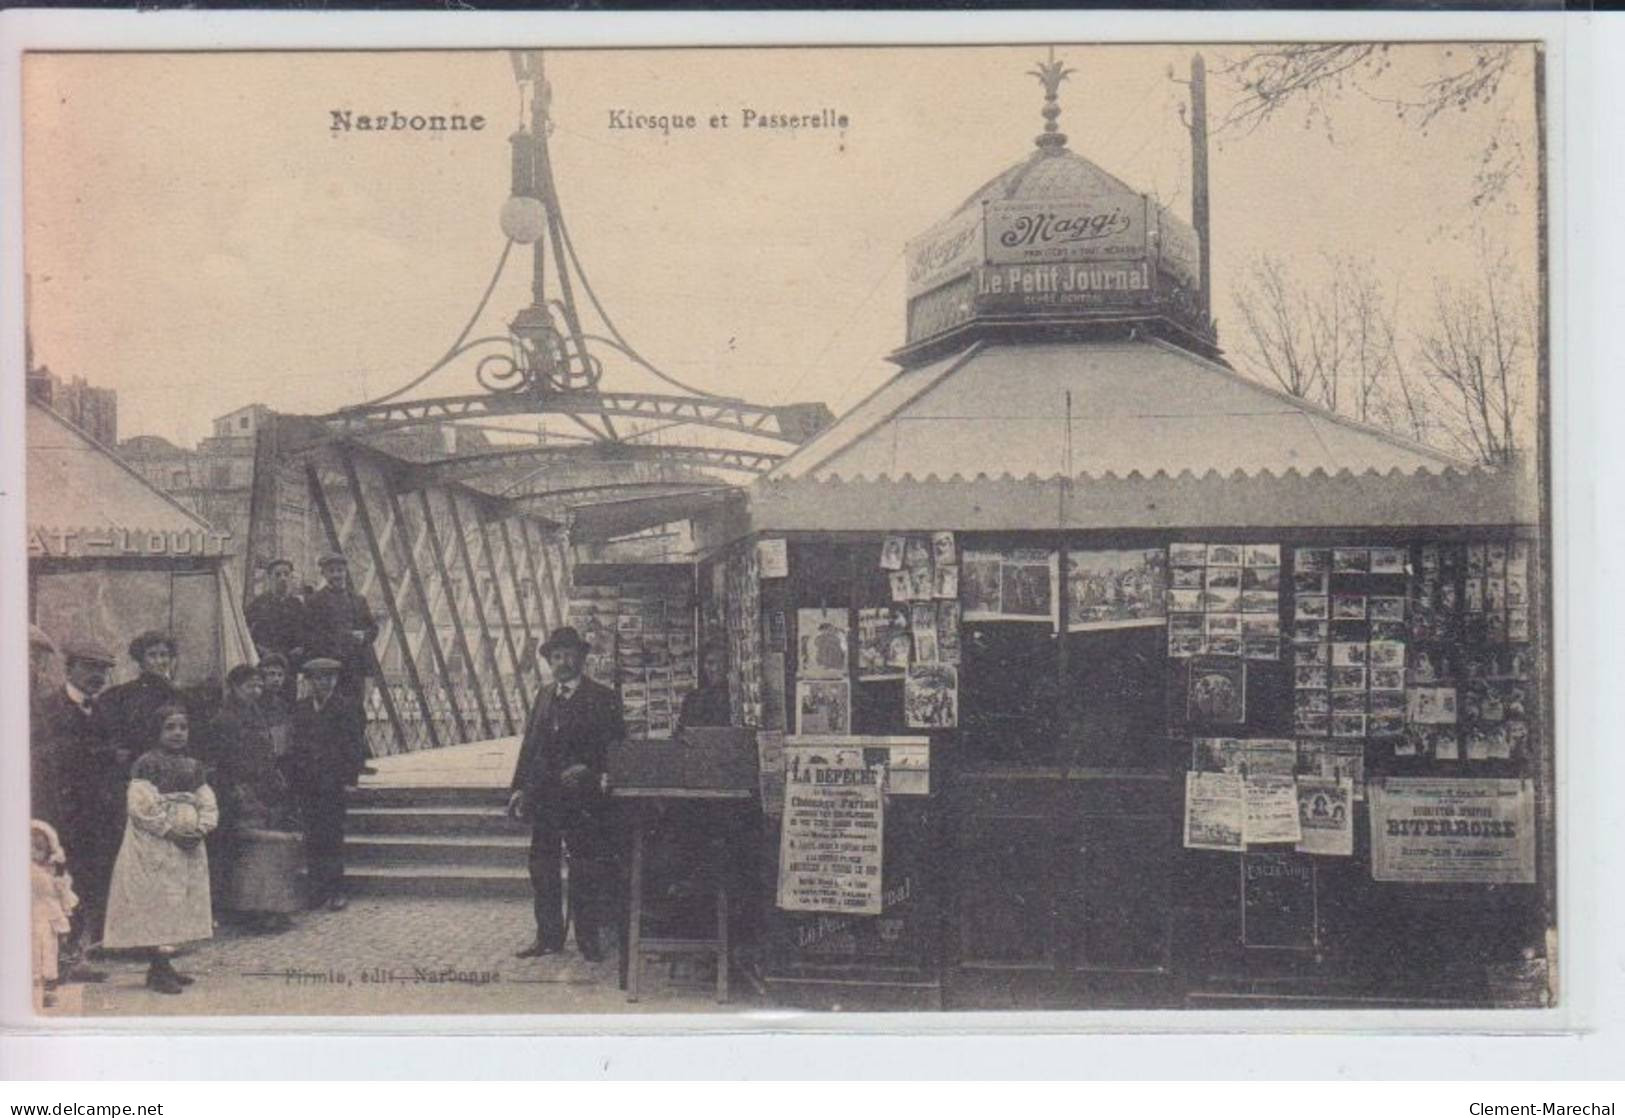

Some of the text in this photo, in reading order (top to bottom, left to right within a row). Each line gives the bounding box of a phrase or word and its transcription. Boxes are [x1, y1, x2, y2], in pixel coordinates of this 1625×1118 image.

[1000, 206, 1131, 248] Maggi
[978, 262, 1149, 295] Le Petit Journal
[1386, 818, 1517, 838] BITERROISE
